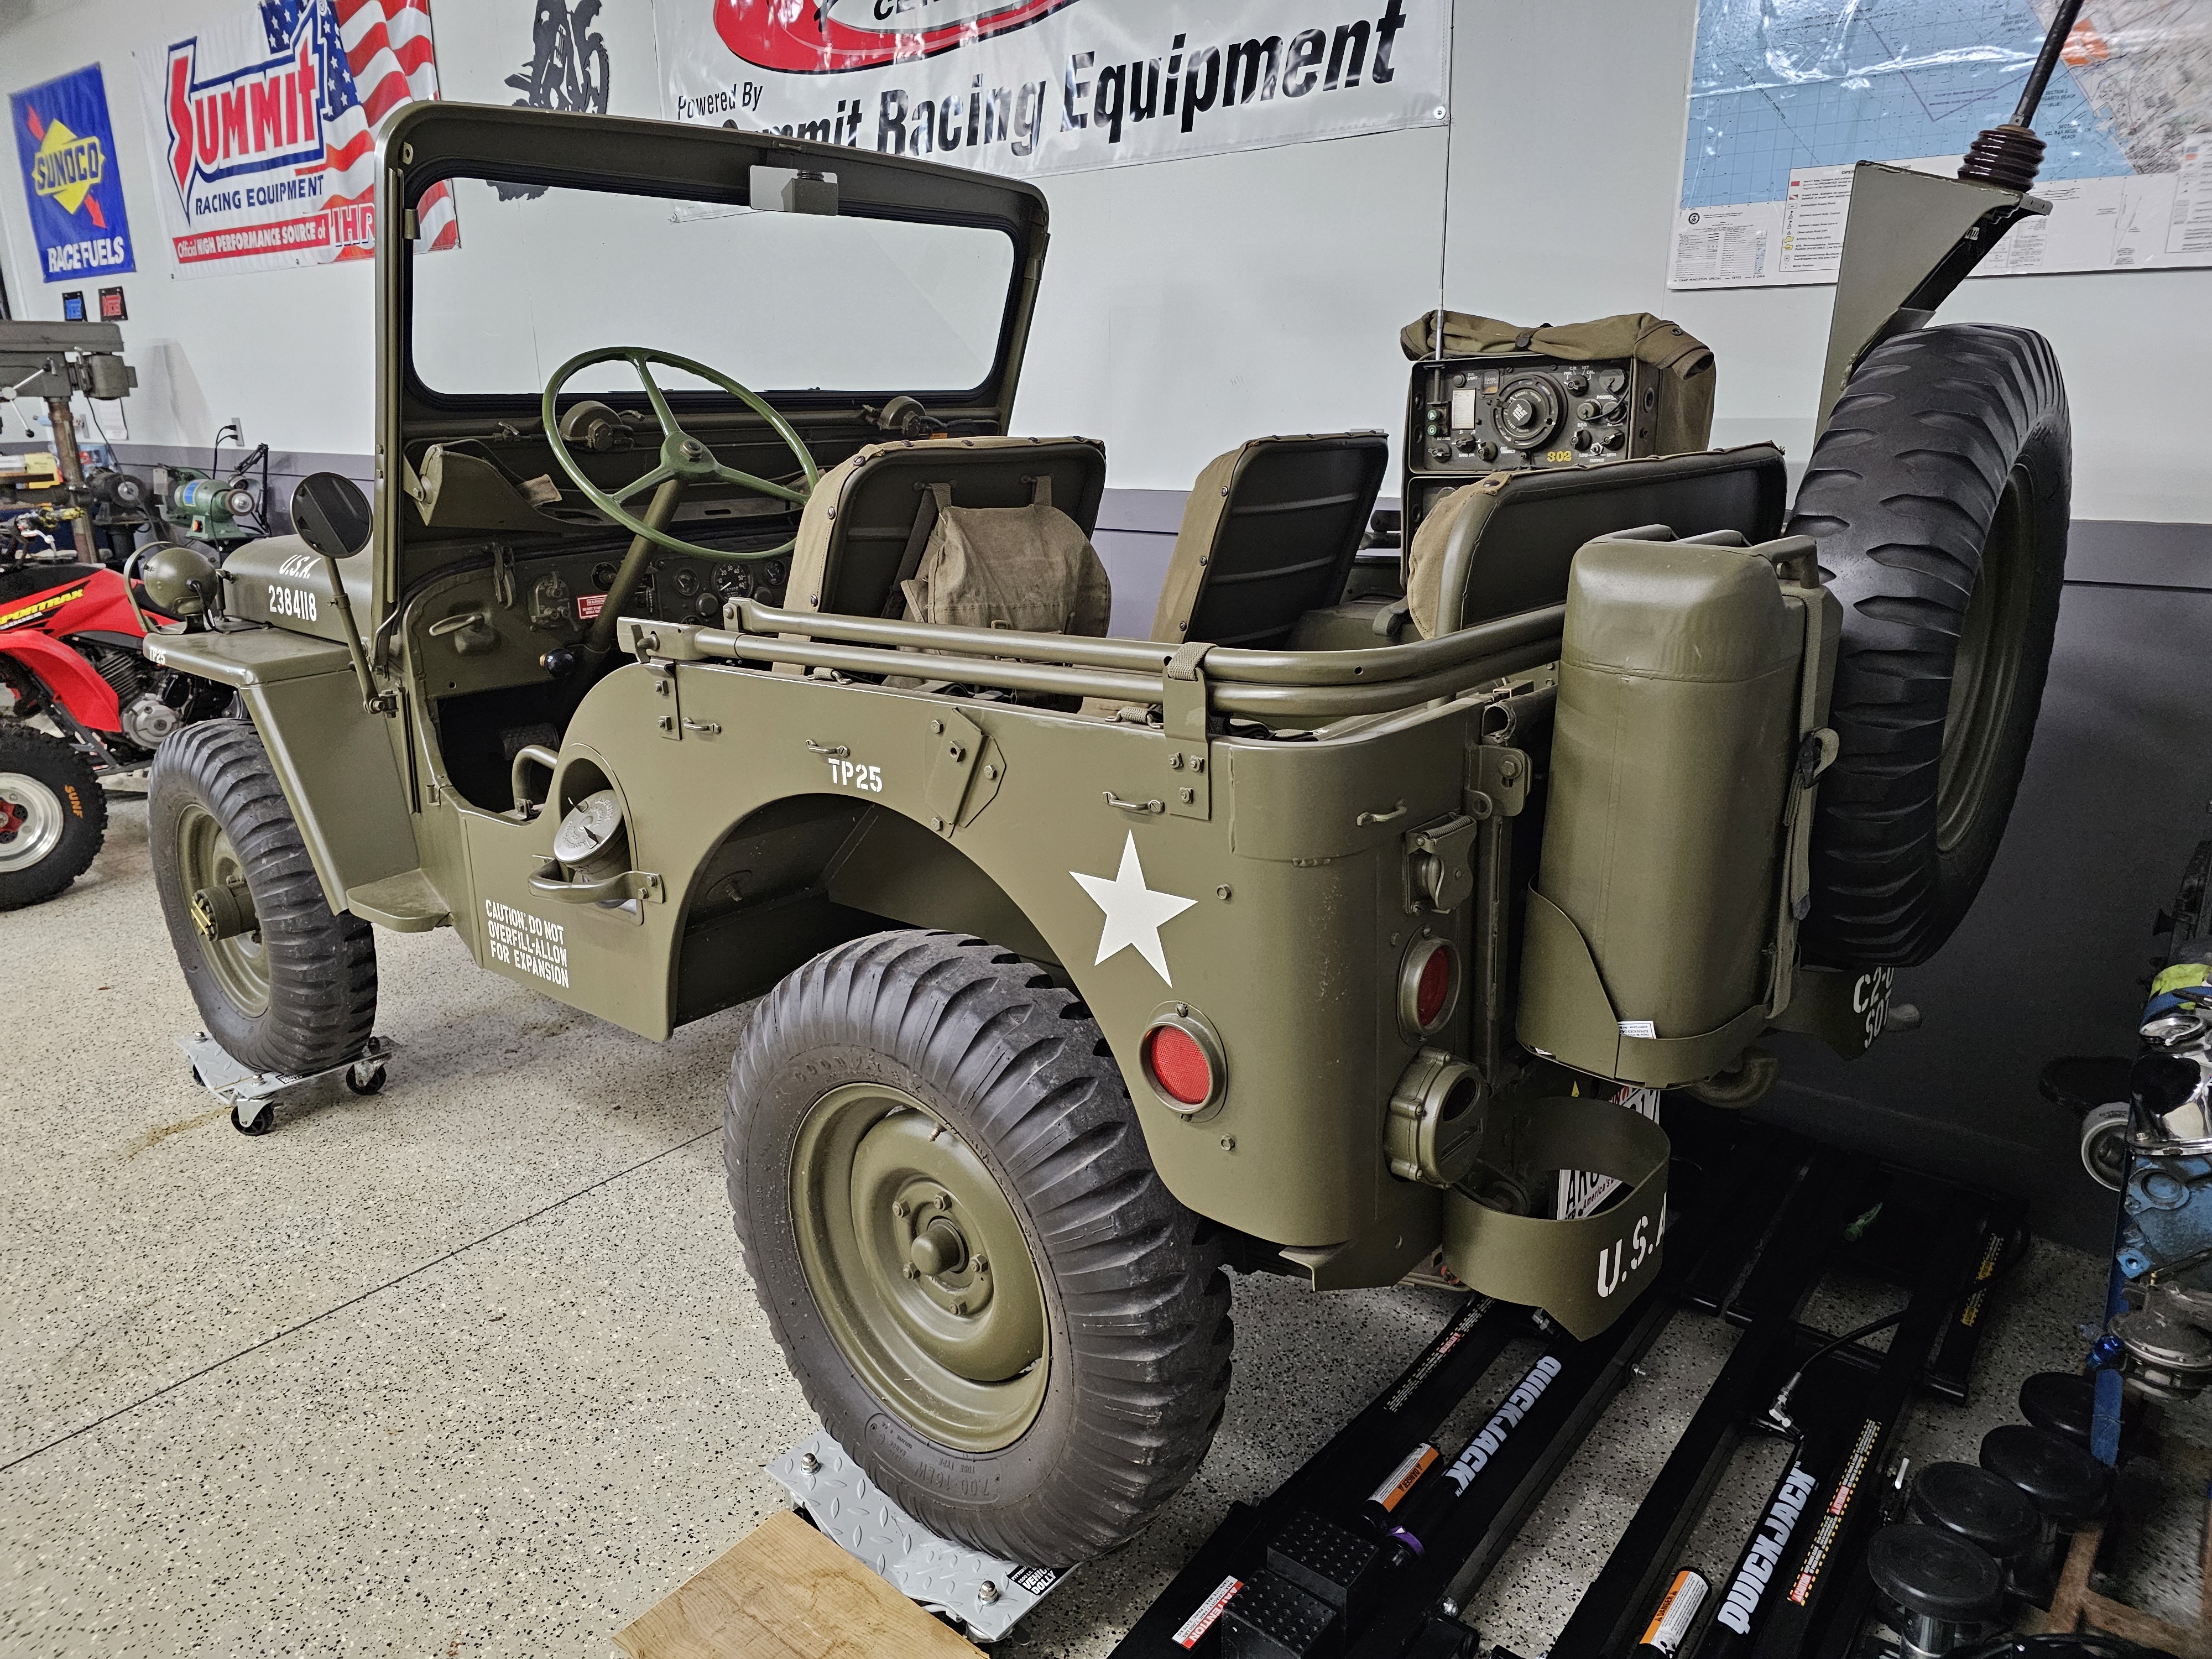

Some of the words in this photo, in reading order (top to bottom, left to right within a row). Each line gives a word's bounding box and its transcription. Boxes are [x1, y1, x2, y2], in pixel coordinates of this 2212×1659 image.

[878, 74, 1047, 157] Racing
[1060, 0, 1407, 144] Equipment
[168, 36, 317, 194] SUMMIT
[679, 83, 737, 120] Powered
[742, 82, 763, 111] By
[36, 142, 100, 191] SUNOCO
[195, 191, 242, 216] RACING
[247, 174, 324, 207] EQUIPMENT
[47, 242, 81, 273] RACE
[81, 236, 125, 268] FUELS
[178, 238, 197, 258] Official
[197, 236, 216, 257] HIGH
[216, 227, 281, 253] PERFORMANCE
[282, 222, 316, 244] SOURCE
[1547, 450, 1572, 462] 302
[279, 554, 322, 580] U.S.A.
[268, 585, 317, 622] 2384118
[148, 645, 167, 665] TP25
[828, 757, 883, 793] TP25
[65, 785, 84, 819] SUNF
[528, 914, 543, 935] DO
[544, 918, 565, 943] NOT
[490, 940, 510, 964] FOR
[514, 949, 570, 989] EXPANSION
[1446, 1356, 1562, 1490] QUICKJACK
[937, 1456, 956, 1470] TYPE
[1402, 1470, 1421, 1488] DANGER
[1834, 1486, 1850, 1510] ATTENTION
[1718, 1467, 1817, 1635] QUICKJACK
[1031, 1570, 1056, 1595] DOLLY
[1223, 1581, 1234, 1592] MAX.
[1795, 1574, 1812, 1597] CAUTION
[1208, 1590, 1225, 1608] CAPACITY
[1658, 1595, 1676, 1618] DANGER
[1180, 1629, 1190, 1639] LBS.
